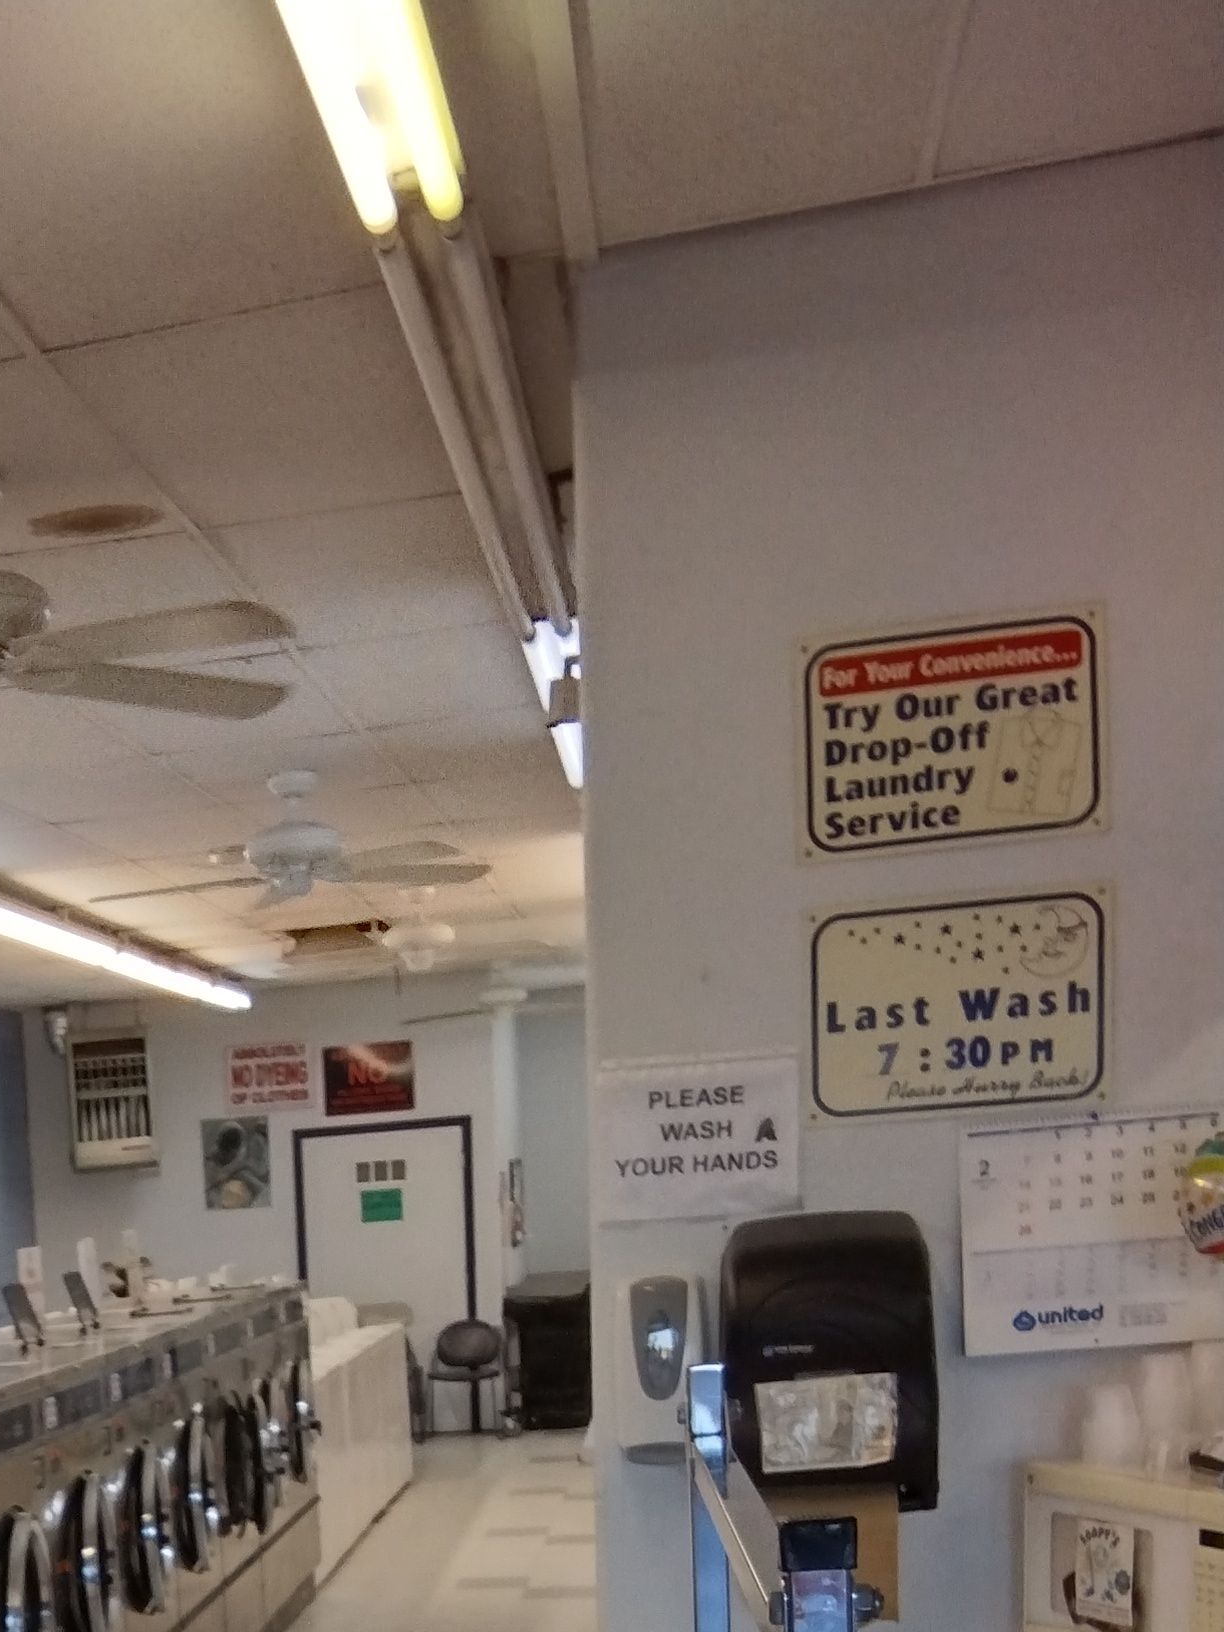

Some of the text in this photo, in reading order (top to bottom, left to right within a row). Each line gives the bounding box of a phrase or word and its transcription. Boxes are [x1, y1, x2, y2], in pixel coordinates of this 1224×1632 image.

[822, 667, 858, 690] For
[864, 660, 914, 684] Your
[824, 677, 1079, 732] Try Our Great
[825, 721, 991, 767] Drop-Off
[825, 764, 975, 803] Laundry
[825, 802, 961, 840] Service
[826, 980, 1091, 1034] Last Wash
[648, 1085, 744, 1110] PLEASE
[660, 1120, 733, 1142] WASH
[615, 1150, 779, 1178] YOUR HANDS
[1038, 1302, 1104, 1324] united
